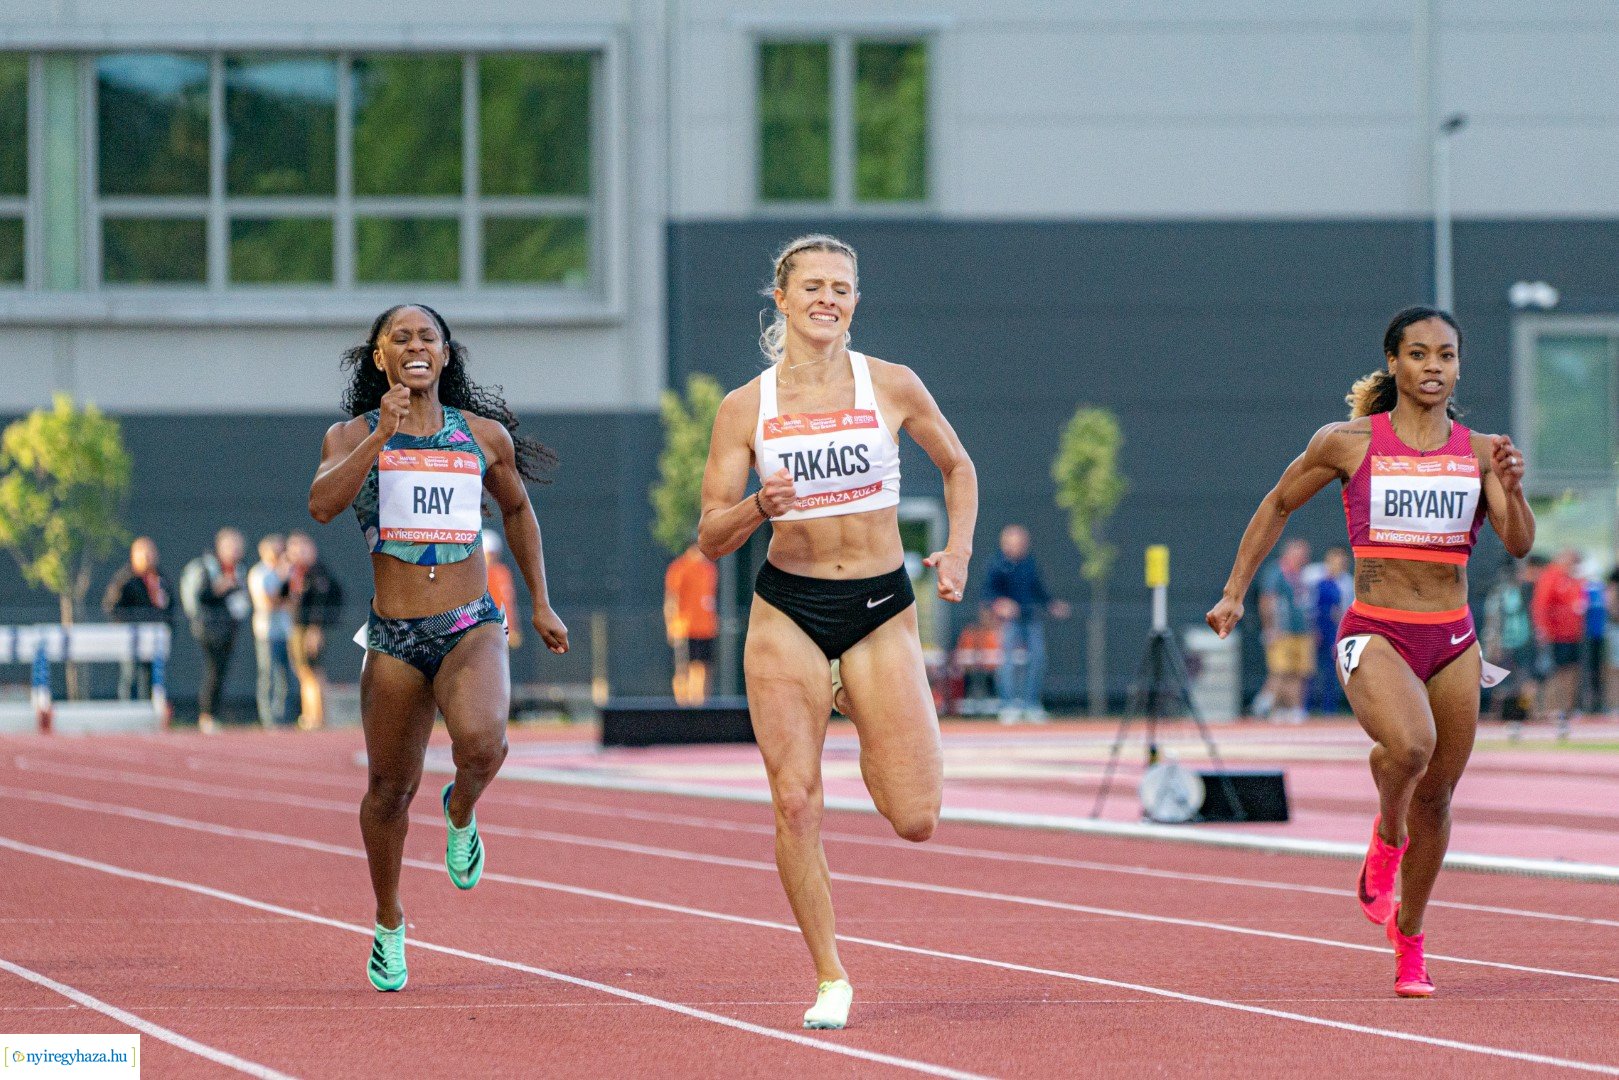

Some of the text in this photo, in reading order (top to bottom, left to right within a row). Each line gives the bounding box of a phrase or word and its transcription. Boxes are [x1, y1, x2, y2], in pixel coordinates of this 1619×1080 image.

[778, 441, 870, 482] TAKÁCS
[413, 486, 454, 514] RAY
[1384, 490, 1468, 518] BRYANT
[387, 529, 452, 540] NYÍREGYHÁZA
[1376, 532, 1465, 544] NYÍREGYHÁZA 2023
[1344, 639, 1356, 673] 3
